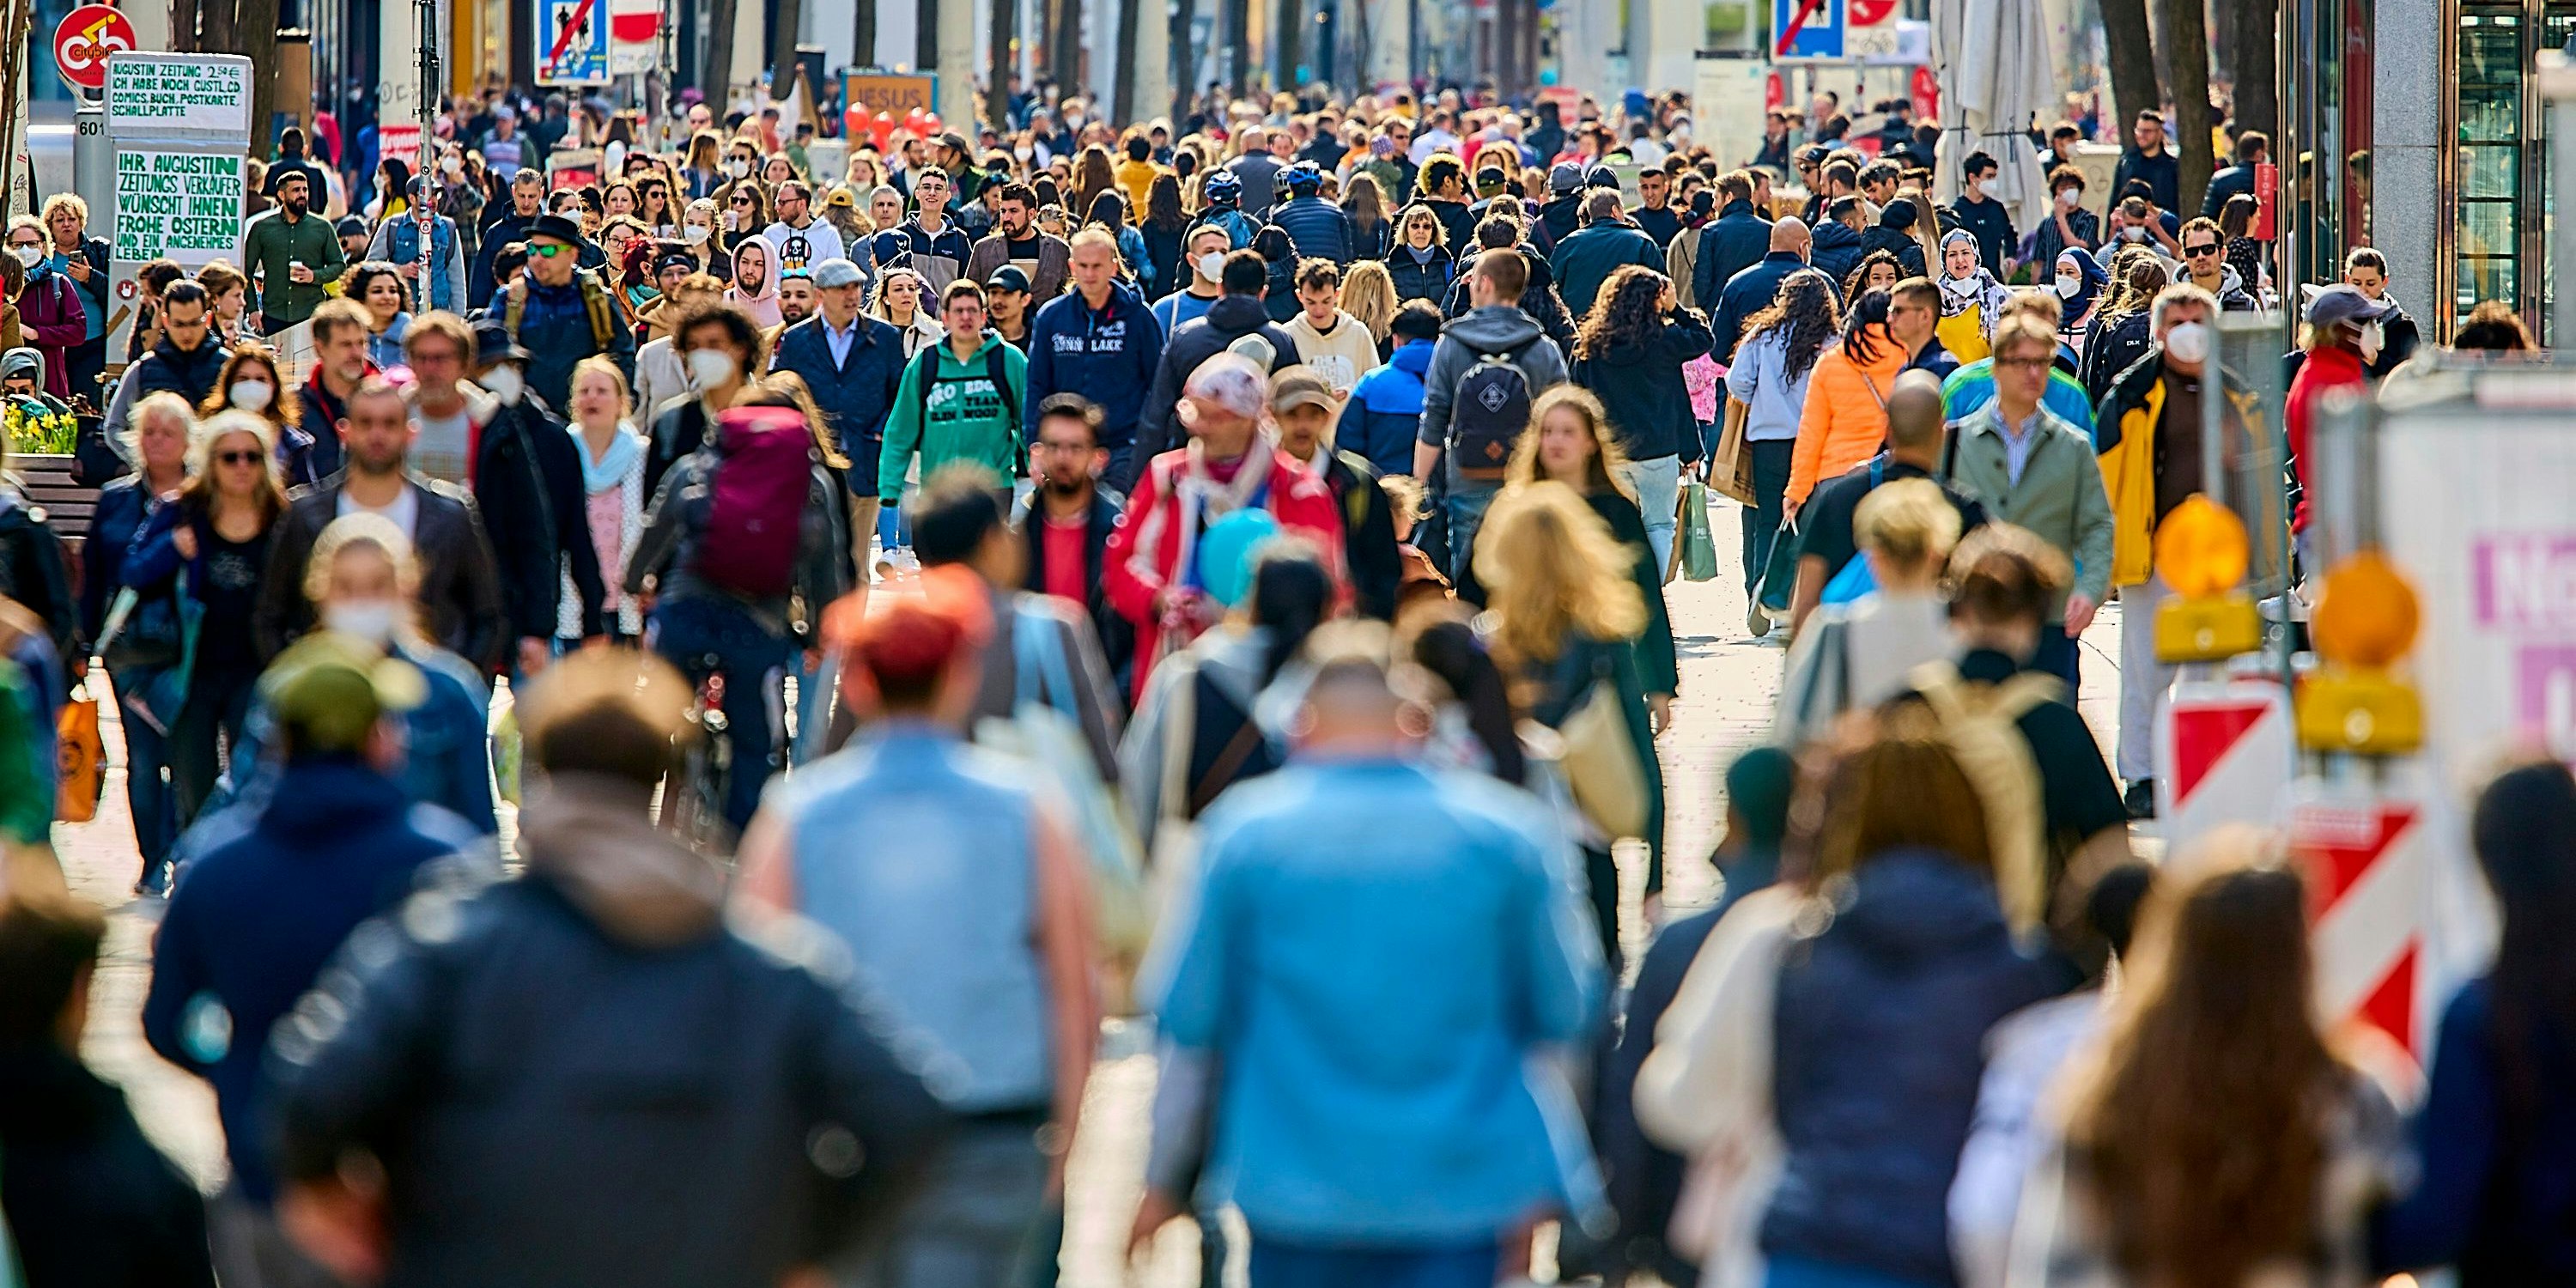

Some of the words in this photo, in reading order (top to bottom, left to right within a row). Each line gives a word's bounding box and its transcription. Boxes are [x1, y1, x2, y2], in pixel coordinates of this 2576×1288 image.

[74, 46, 112, 59] citybik
[113, 64, 155, 76] AUGUSTIN
[160, 64, 201, 77] ZEITUNG
[112, 77, 128, 89] ICH
[132, 78, 158, 90] HABE
[161, 79, 189, 91] NOCH
[857, 88, 922, 109] JESUS
[112, 105, 185, 116] SCHALLPLATTE
[80, 122, 104, 136] 601
[119, 153, 145, 172] IHR
[154, 155, 238, 175] AUGUSTIN
[119, 173, 178, 193] ZEITUNGS
[184, 175, 240, 196] VERKÄUFER
[118, 193, 183, 215] WÜNSCHT
[189, 197, 238, 216] IHNEN
[118, 215, 164, 234] FROHE
[172, 216, 239, 236] OSTERN
[117, 234, 137, 247] UND
[143, 234, 160, 248] EIN
[166, 235, 234, 250] ANGENEHMES
[116, 248, 164, 260] LEBEN
[1091, 339, 1123, 352] LAKE
[927, 382, 957, 411] PRO
[965, 396, 1000, 406] TEAM
